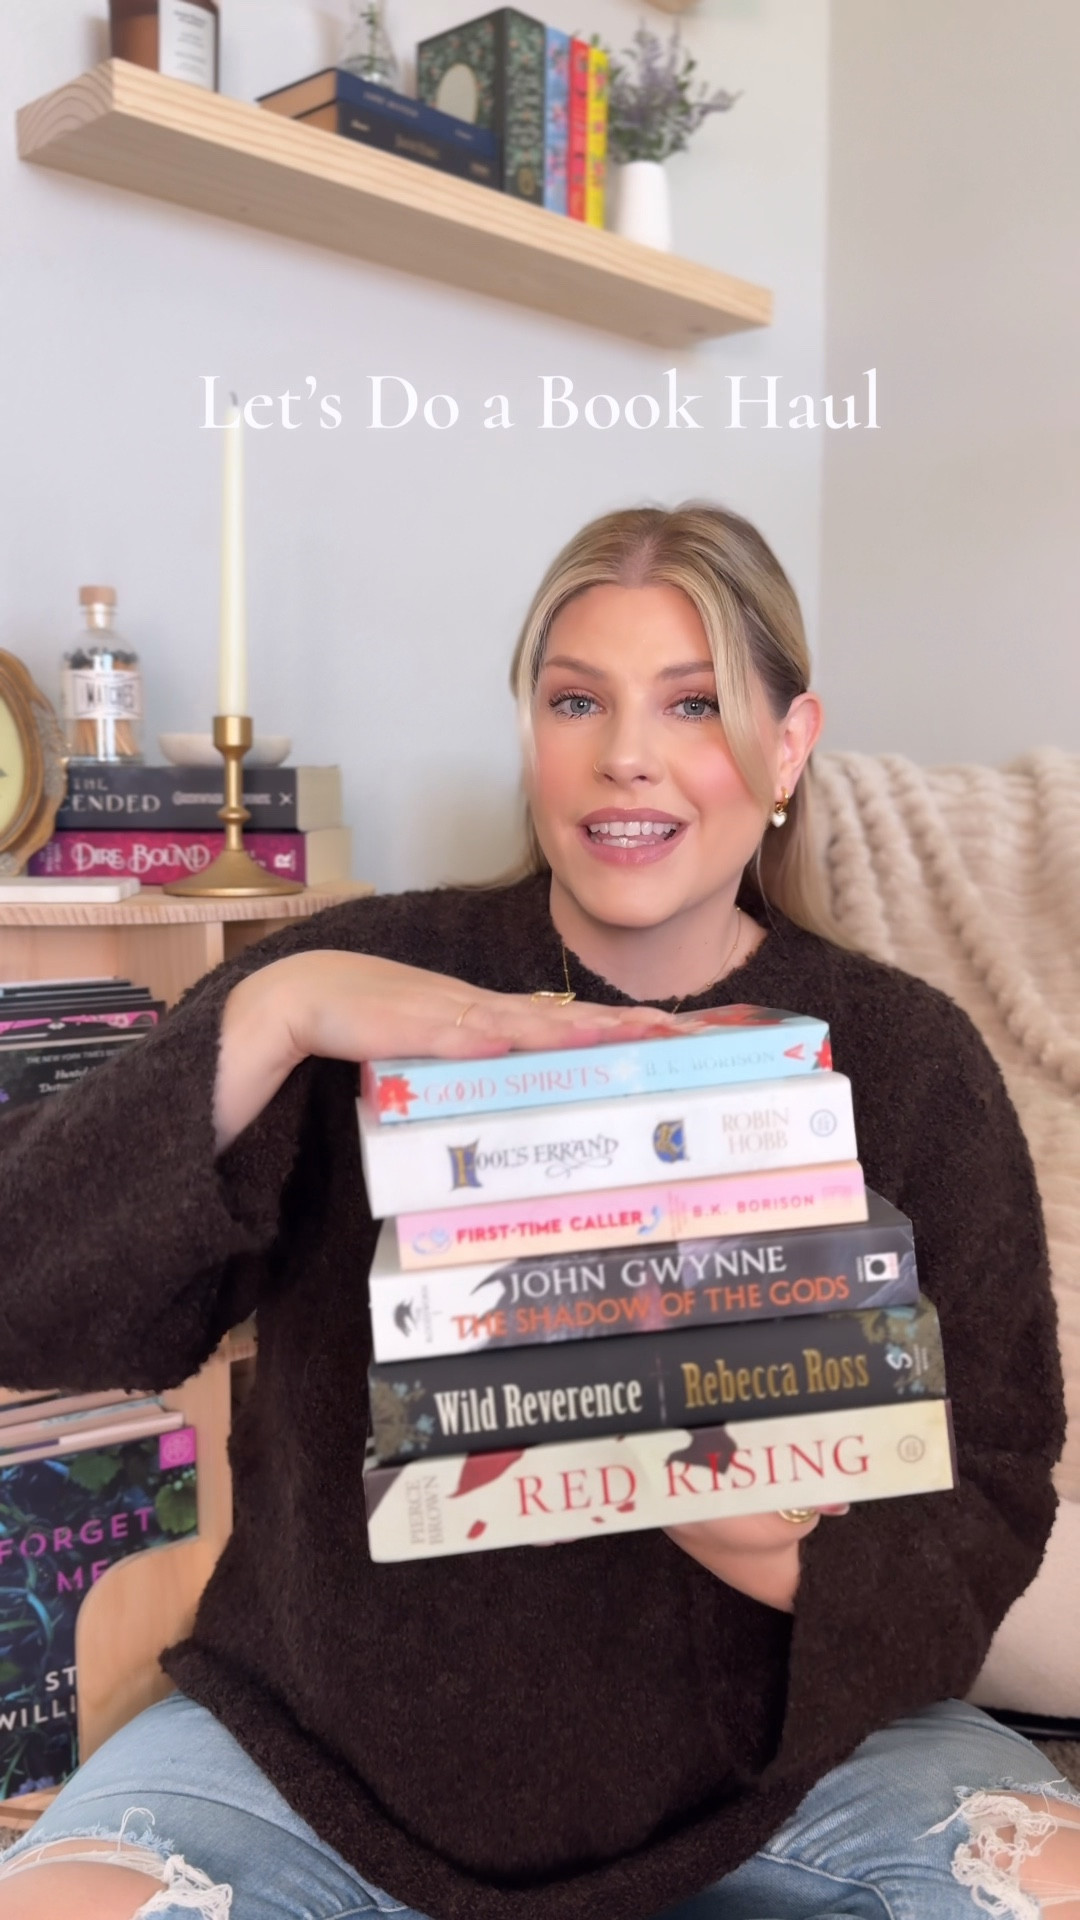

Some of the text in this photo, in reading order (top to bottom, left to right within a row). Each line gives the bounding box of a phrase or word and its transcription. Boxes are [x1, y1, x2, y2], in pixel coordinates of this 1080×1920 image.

[423, 1077, 497, 1106] GOOD
[505, 1065, 610, 1095] SPIRITS
[722, 1107, 790, 1133] ROBIN
[728, 1130, 788, 1155] HOBB
[535, 1133, 619, 1178] ERRAND
[456, 1218, 562, 1244] FIRST-TIME
[570, 1210, 643, 1233] CALLER
[737, 1194, 815, 1214] BORISON
[509, 1245, 788, 1302] JOHN GWYNNE
[451, 1313, 508, 1341] THE
[516, 1294, 650, 1331] SHADOW
[659, 1290, 696, 1317] OF
[703, 1283, 763, 1312] THE
[768, 1274, 850, 1306] GODS
[434, 1386, 498, 1437] Wild
[502, 1379, 644, 1430] Reverence
[680, 1358, 799, 1409] Rebecca
[802, 1347, 871, 1394] Ross
[513, 1433, 871, 1518] RED RISING
[0, 1506, 155, 1565] FORGET
[405, 1477, 427, 1545] PIERCE
[425, 1473, 445, 1546] BROWN
